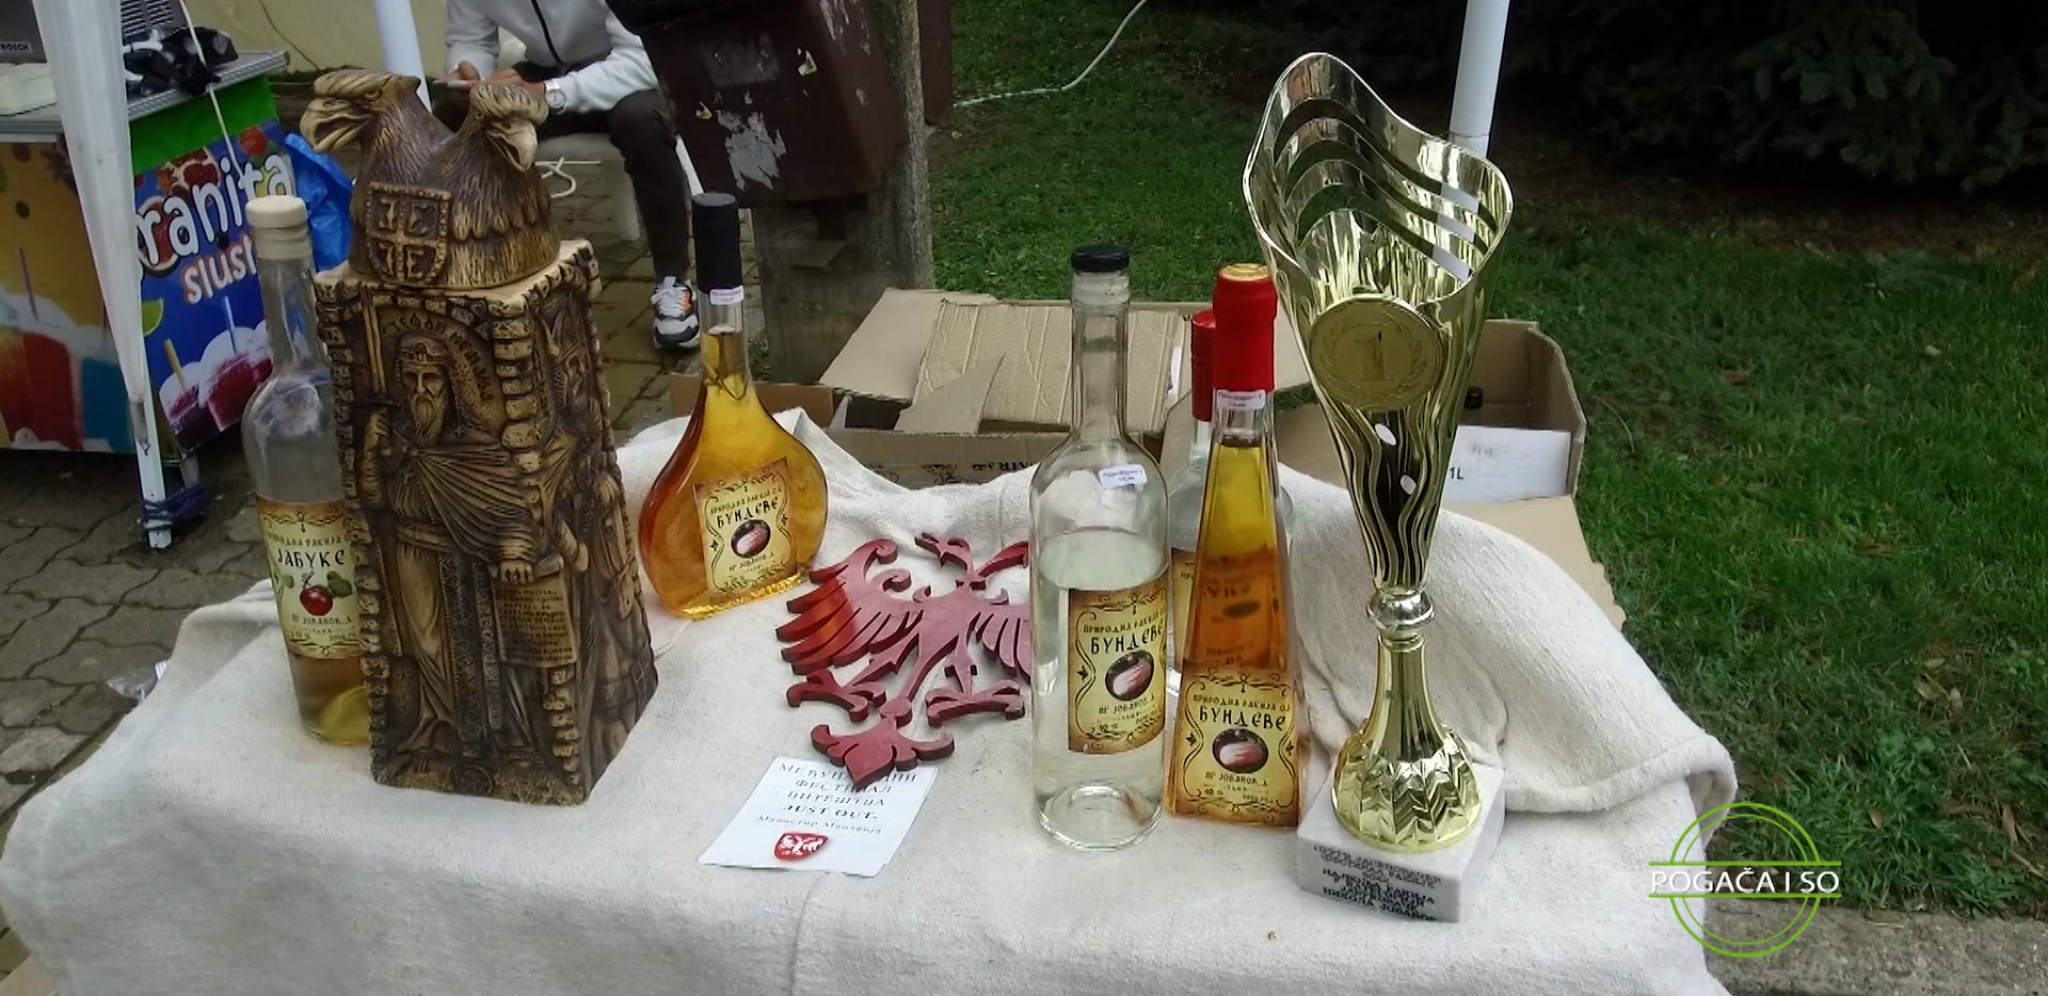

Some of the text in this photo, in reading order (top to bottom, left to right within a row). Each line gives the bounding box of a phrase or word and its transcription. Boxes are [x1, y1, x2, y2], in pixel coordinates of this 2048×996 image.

[136, 153, 293, 266] ranita
[1449, 466, 1465, 480] 1L
[717, 496, 778, 528] БУНДЕВЕ
[1083, 622, 1131, 635] ПРИРОДНА
[1091, 618, 1163, 655] БУНДЕВЕ
[1193, 694, 1239, 707] ПРИРОДНА
[1242, 701, 1276, 712] РАКИЈА
[1199, 705, 1286, 731] БУНДЕВЕ
[795, 779, 892, 794] ФЕСТИАЛ
